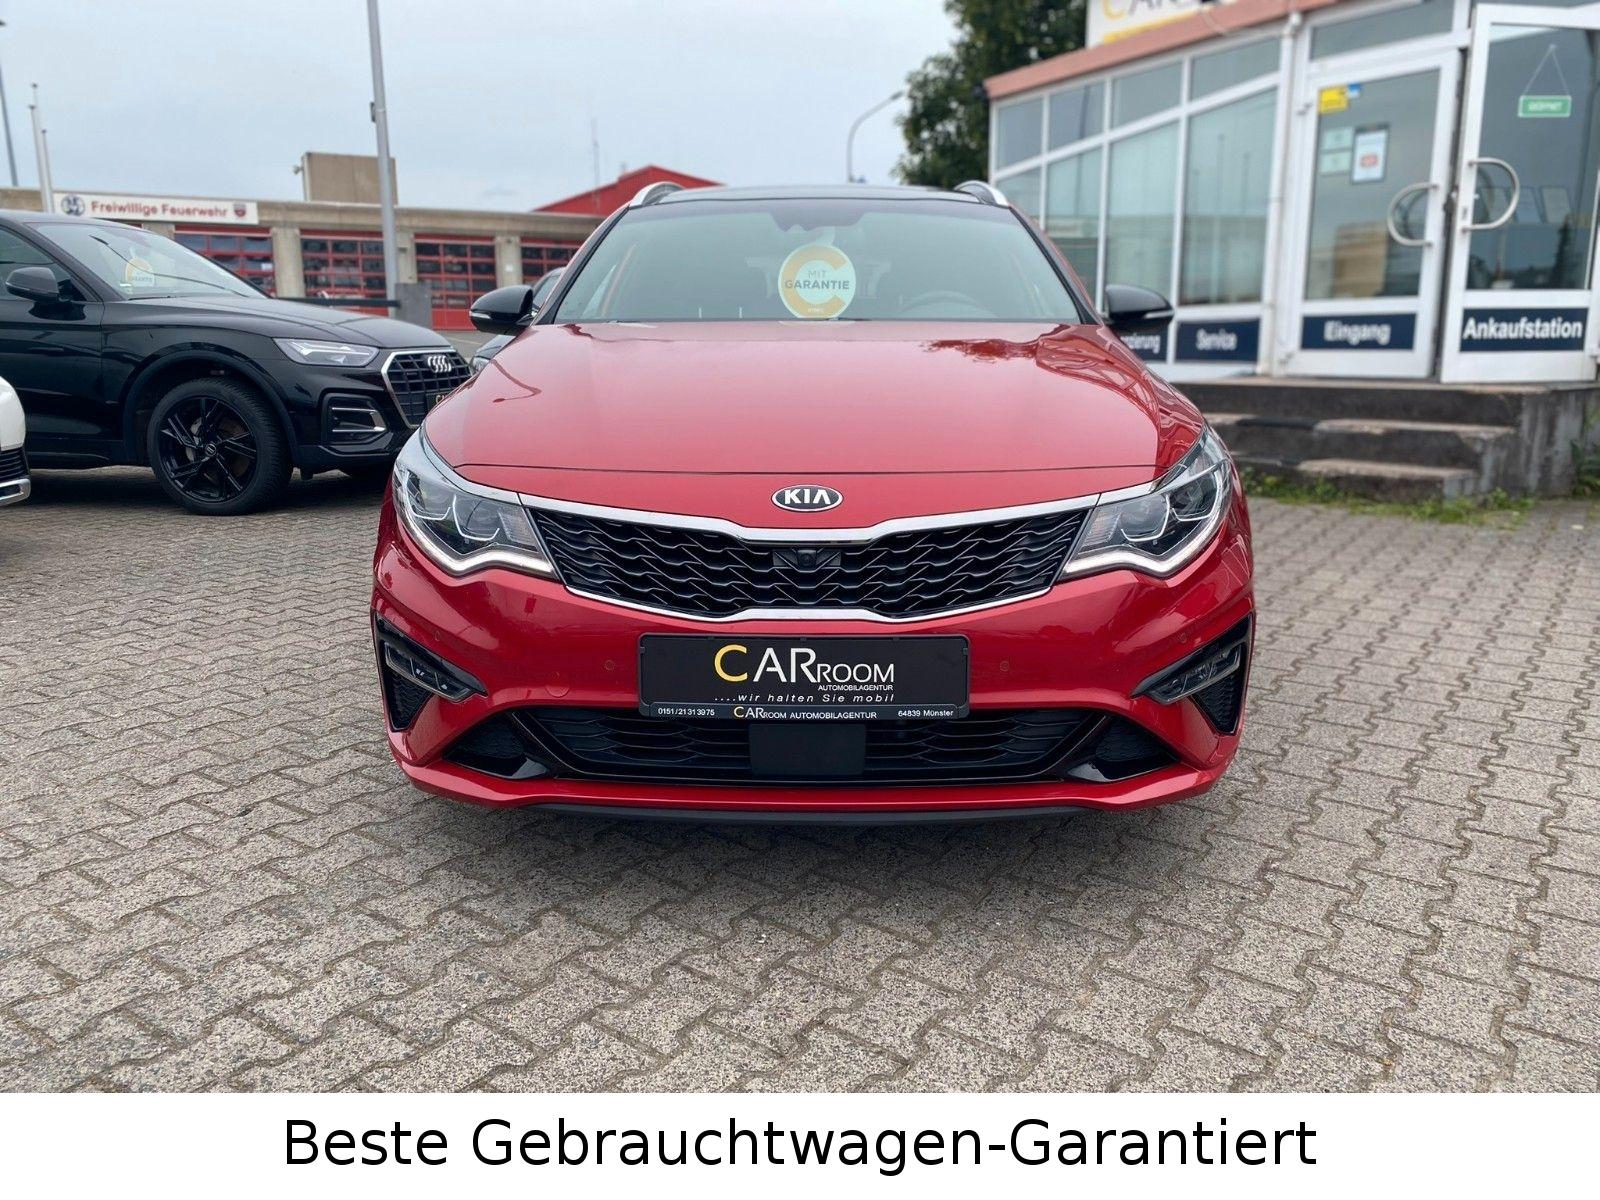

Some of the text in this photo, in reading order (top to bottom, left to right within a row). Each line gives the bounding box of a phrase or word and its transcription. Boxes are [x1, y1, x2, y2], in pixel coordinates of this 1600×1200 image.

[91, 201, 228, 217] Freiwillige Feuerwehr
[808, 270, 827, 279] MIT
[784, 280, 850, 290] GARANTIE
[1323, 320, 1391, 345] Eingang
[1463, 317, 1583, 340] Ankaufstation
[1196, 328, 1237, 350] Service
[784, 488, 832, 505] KIA
[817, 684, 894, 692] AUTOMOBILAGENTUR
[767, 693, 814, 703] halten
[822, 693, 845, 703] Sie
[852, 693, 895, 703] mobil
[657, 707, 716, 716] 0151/21313975
[789, 711, 877, 720] AUTOMOBILAGENTUR
[898, 709, 921, 717] 64839
[923, 708, 955, 718] Münster
